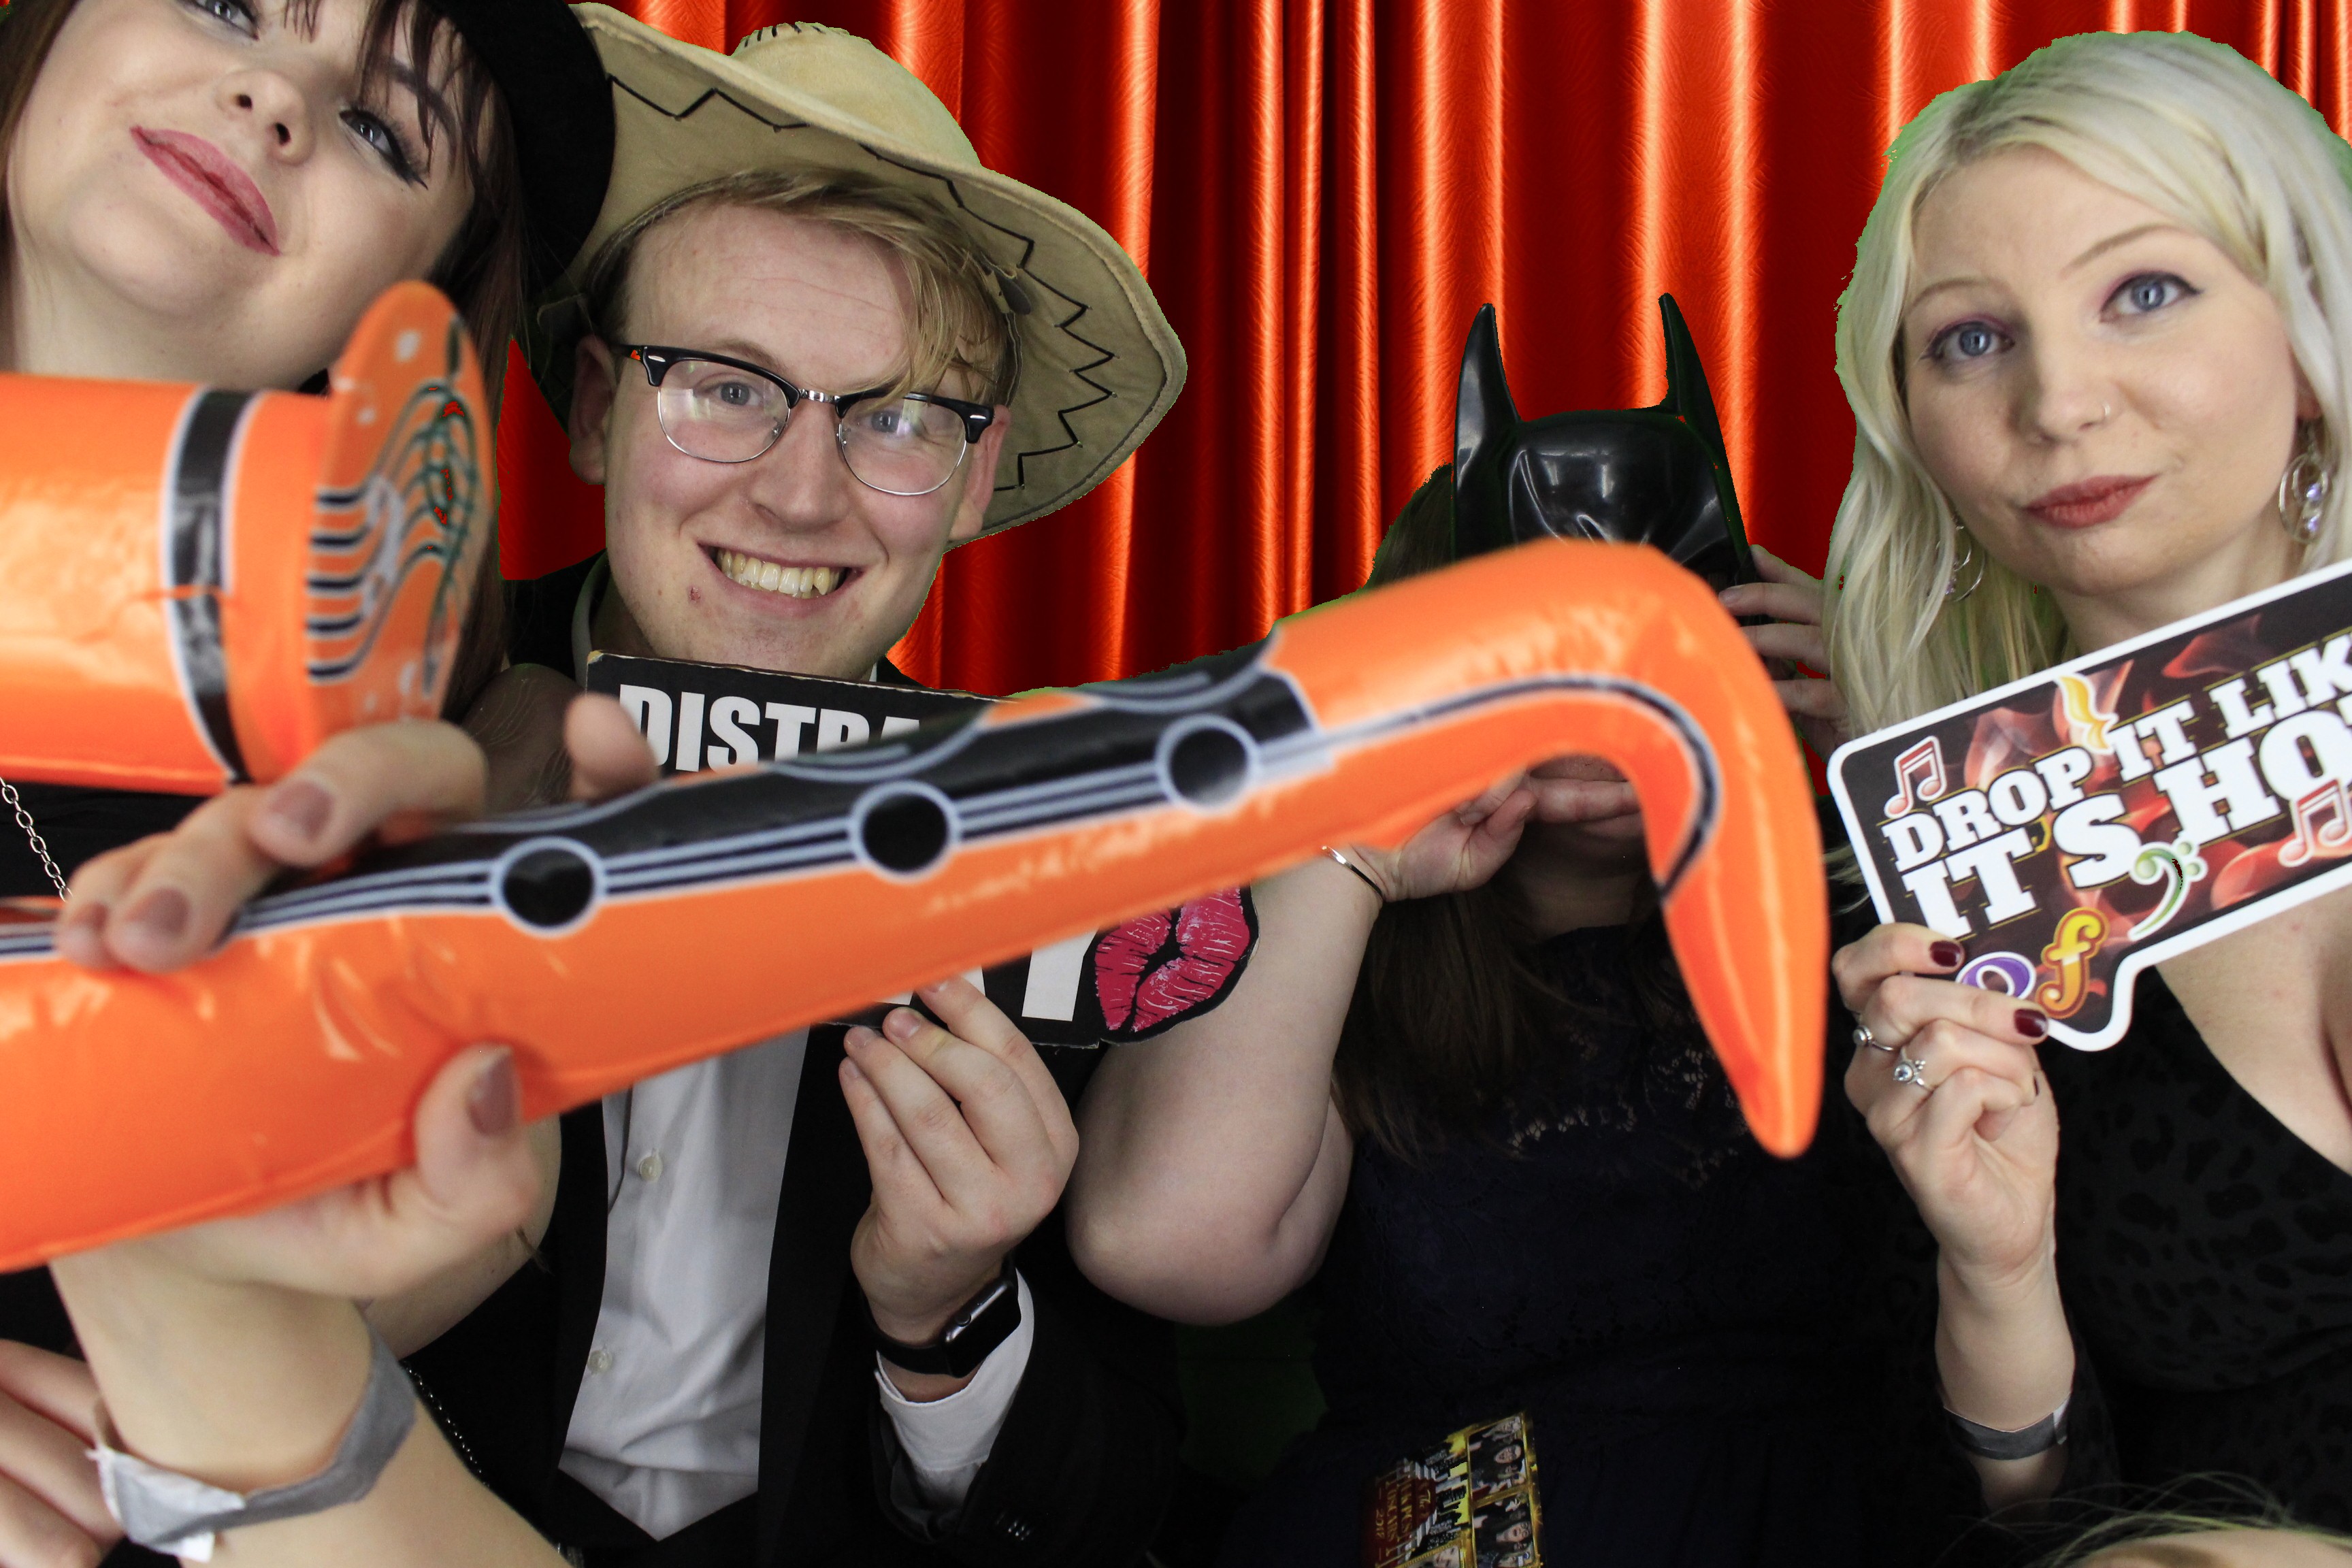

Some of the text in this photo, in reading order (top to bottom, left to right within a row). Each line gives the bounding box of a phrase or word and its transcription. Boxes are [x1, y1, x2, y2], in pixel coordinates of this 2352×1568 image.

[1881, 634, 2352, 872] DROP IT LIK
[2153, 693, 2352, 846] HO
